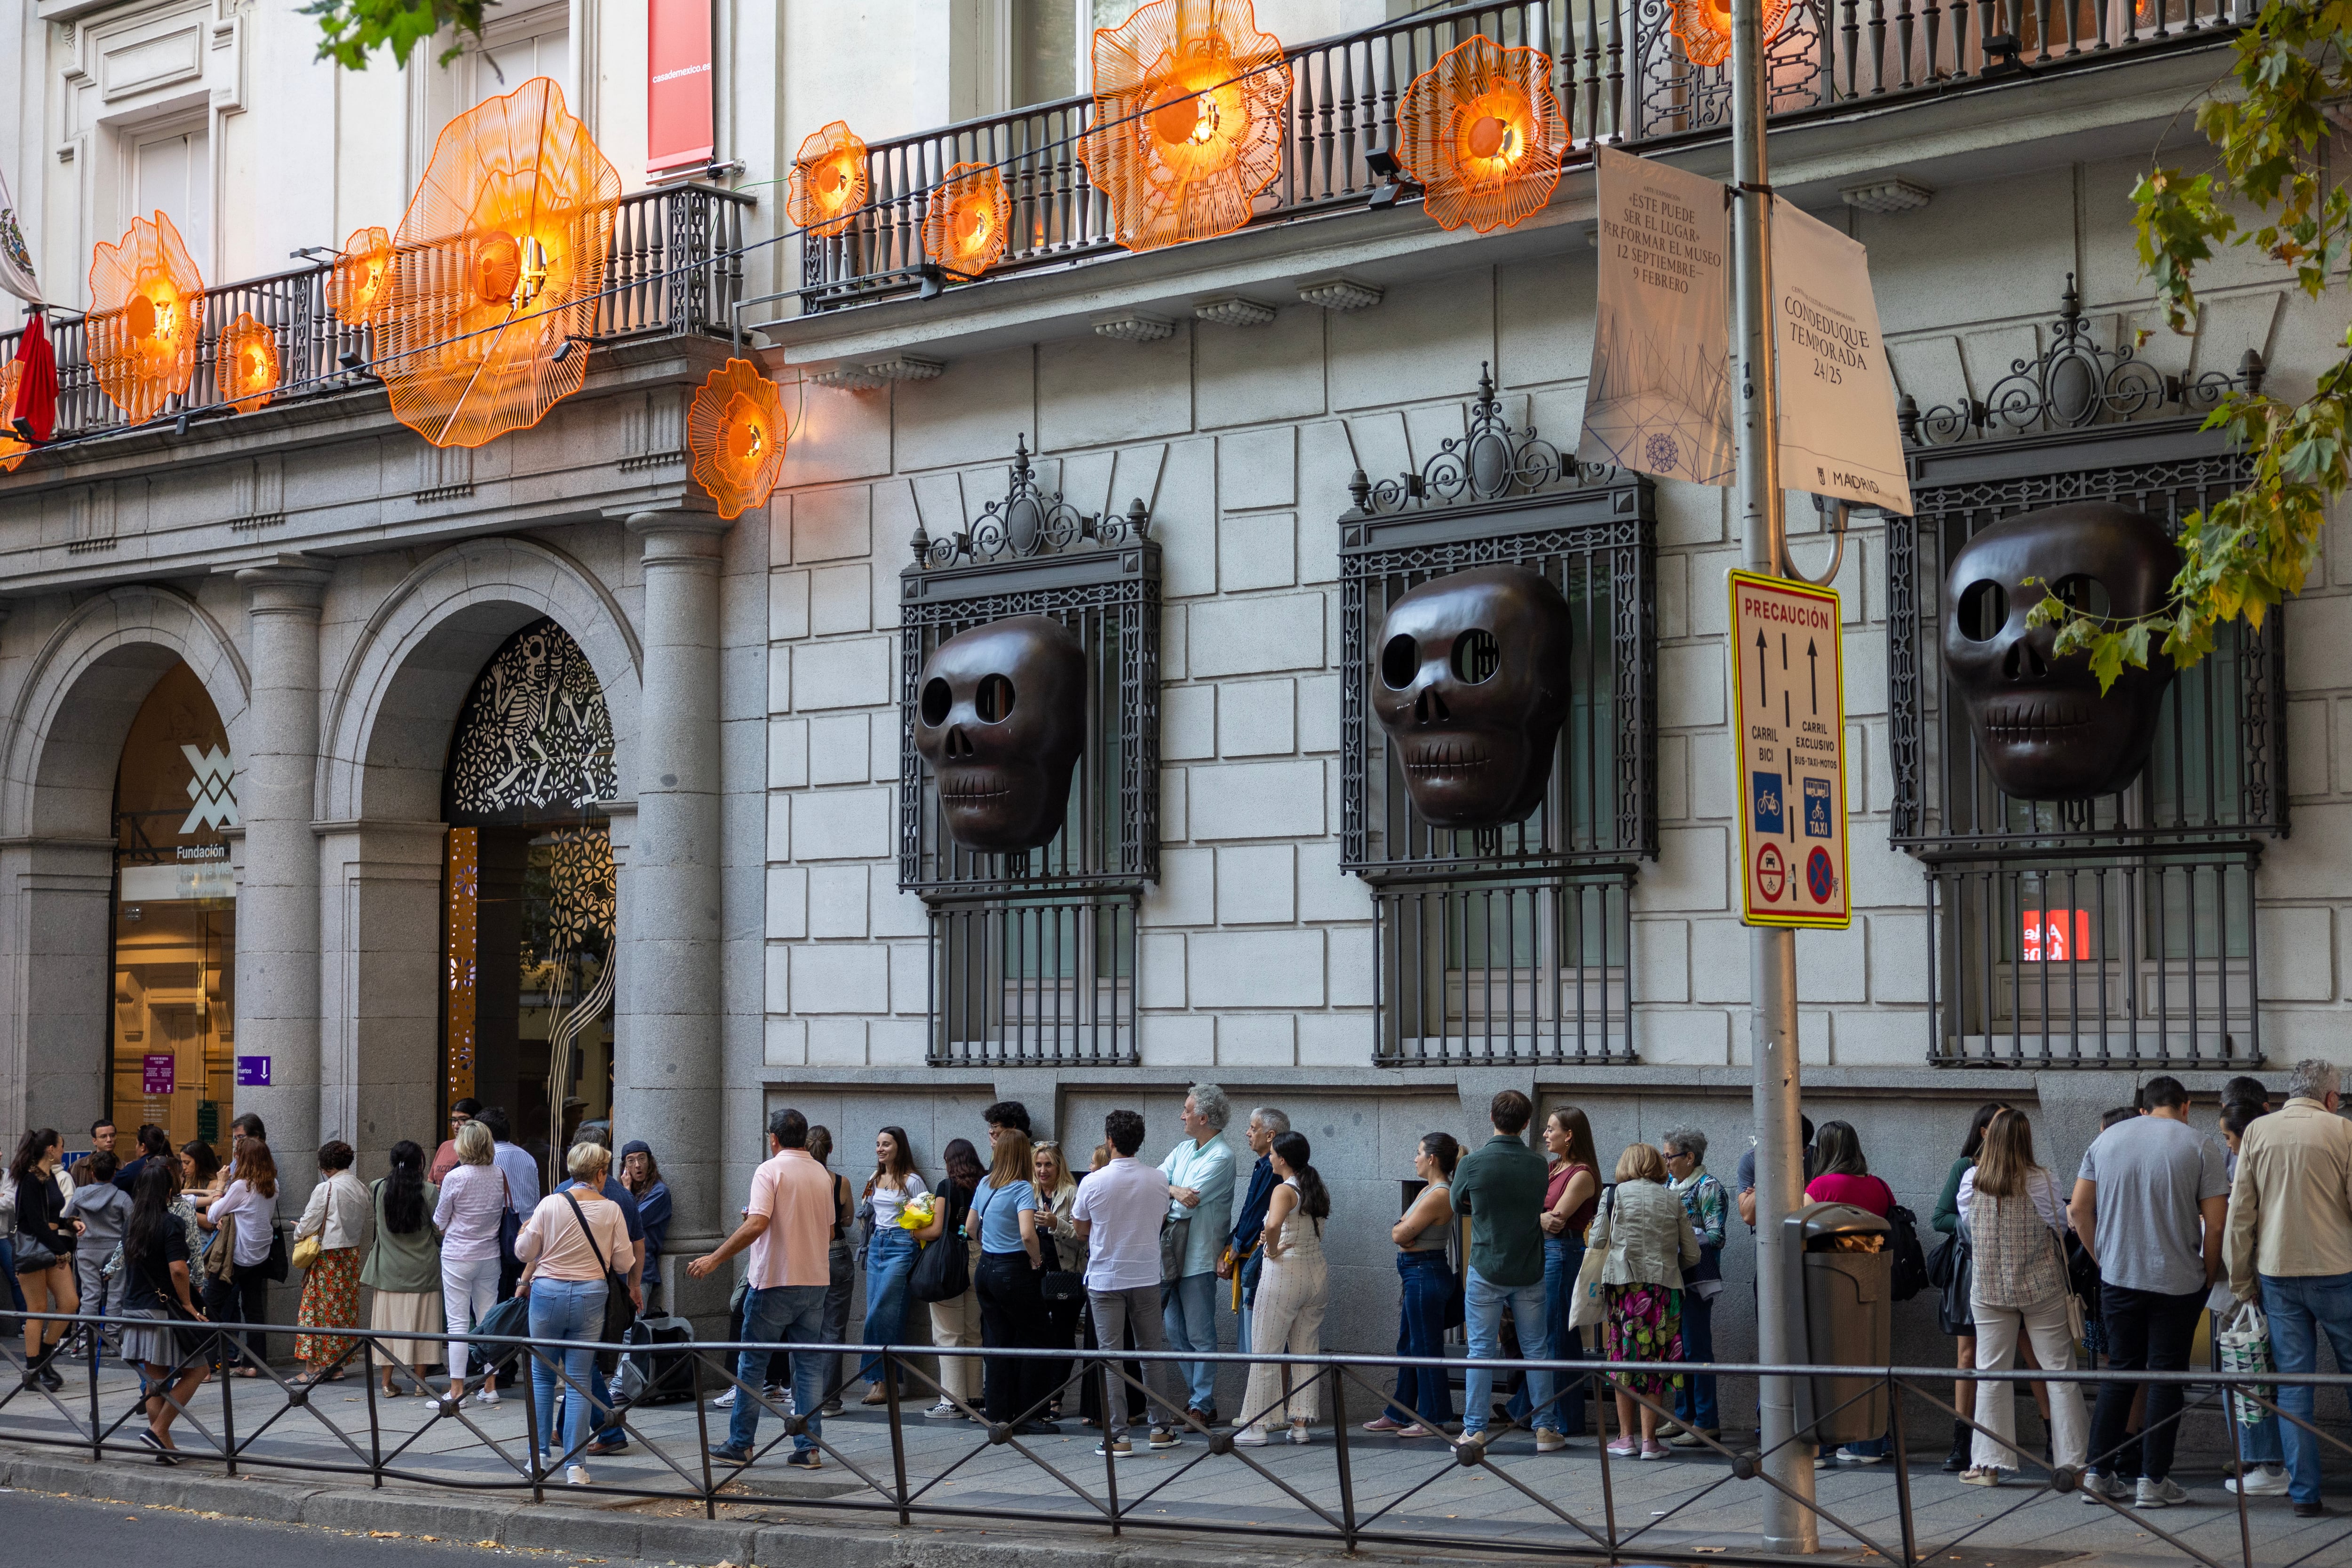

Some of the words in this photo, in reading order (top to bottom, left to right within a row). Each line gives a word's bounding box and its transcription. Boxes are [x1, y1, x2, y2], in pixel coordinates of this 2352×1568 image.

[652, 62, 711, 84] casademexico.es
[1629, 193, 1657, 213] «ESTE
[1661, 202, 1695, 224] PUEDE
[1624, 208, 1641, 226] SER
[1645, 215, 1657, 230] EL
[1661, 220, 1700, 243] LUGAR»
[1604, 219, 1666, 252] PERFORMAR
[1669, 241, 1682, 256] EL
[1685, 245, 1721, 267] MUSEO
[1617, 244, 1628, 259] 12
[1633, 266, 1639, 279] 9
[1643, 269, 1688, 294] FEBRERO
[1785, 296, 1869, 350] CONDEDUQUE
[1790, 322, 1867, 370] TEMPORADA
[1814, 358, 1843, 385] 24/25
[1833, 471, 1879, 494] MADRID
[1745, 598, 1829, 630] PRECAUCIÓN
[1752, 725, 1778, 742] CARRIL
[1802, 721, 1828, 735] CARRIL
[1759, 747, 1773, 762] BICI
[1796, 736, 1835, 752] EXCLUSIVO
[1810, 821, 1828, 836] TAXI
[177, 843, 224, 859] Fundación
[201, 862, 213, 876] de
